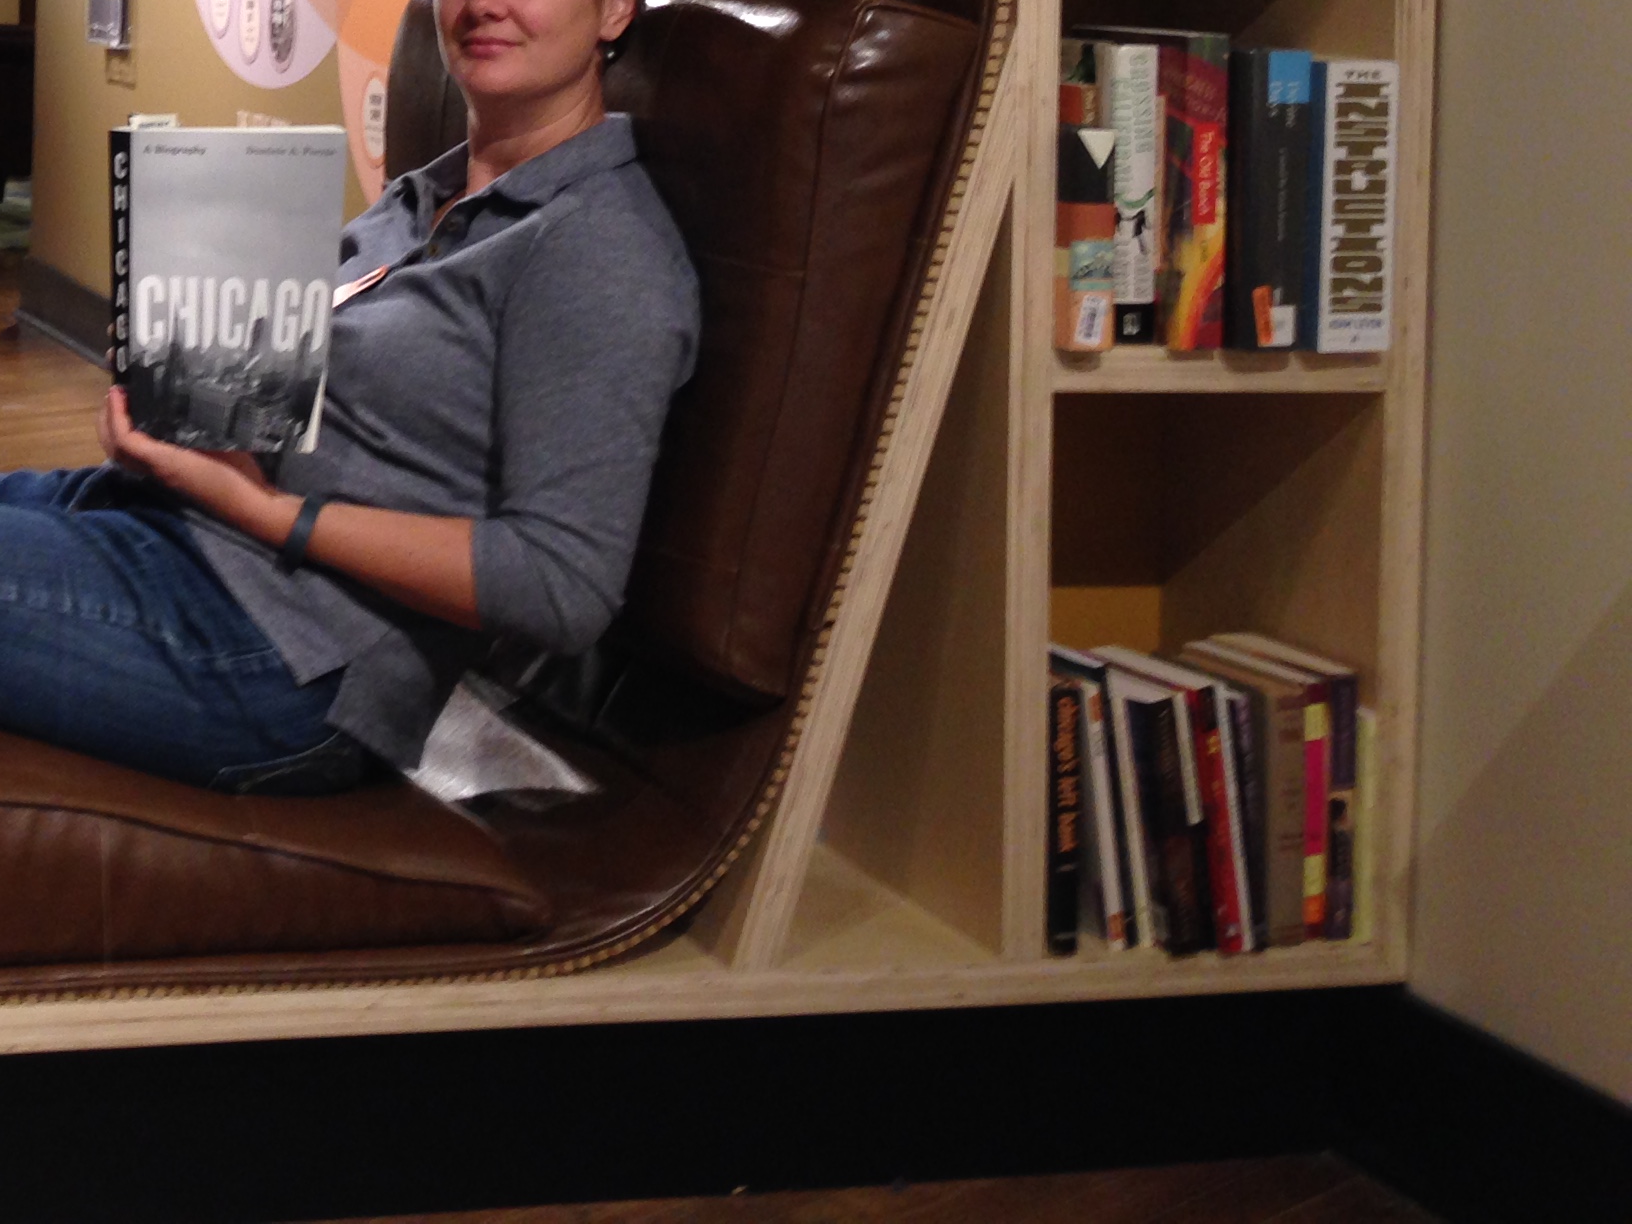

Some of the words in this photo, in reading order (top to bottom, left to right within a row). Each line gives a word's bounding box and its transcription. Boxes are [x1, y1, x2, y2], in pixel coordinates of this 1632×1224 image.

[153, 144, 207, 157] Biography
[1200, 132, 1213, 155] The
[1199, 158, 1214, 177] Old
[1198, 181, 1214, 216] Bunch
[1329, 82, 1392, 314] INSTRUCTIONS
[113, 152, 130, 374] CHICAGO
[135, 274, 333, 354] CHICAGO
